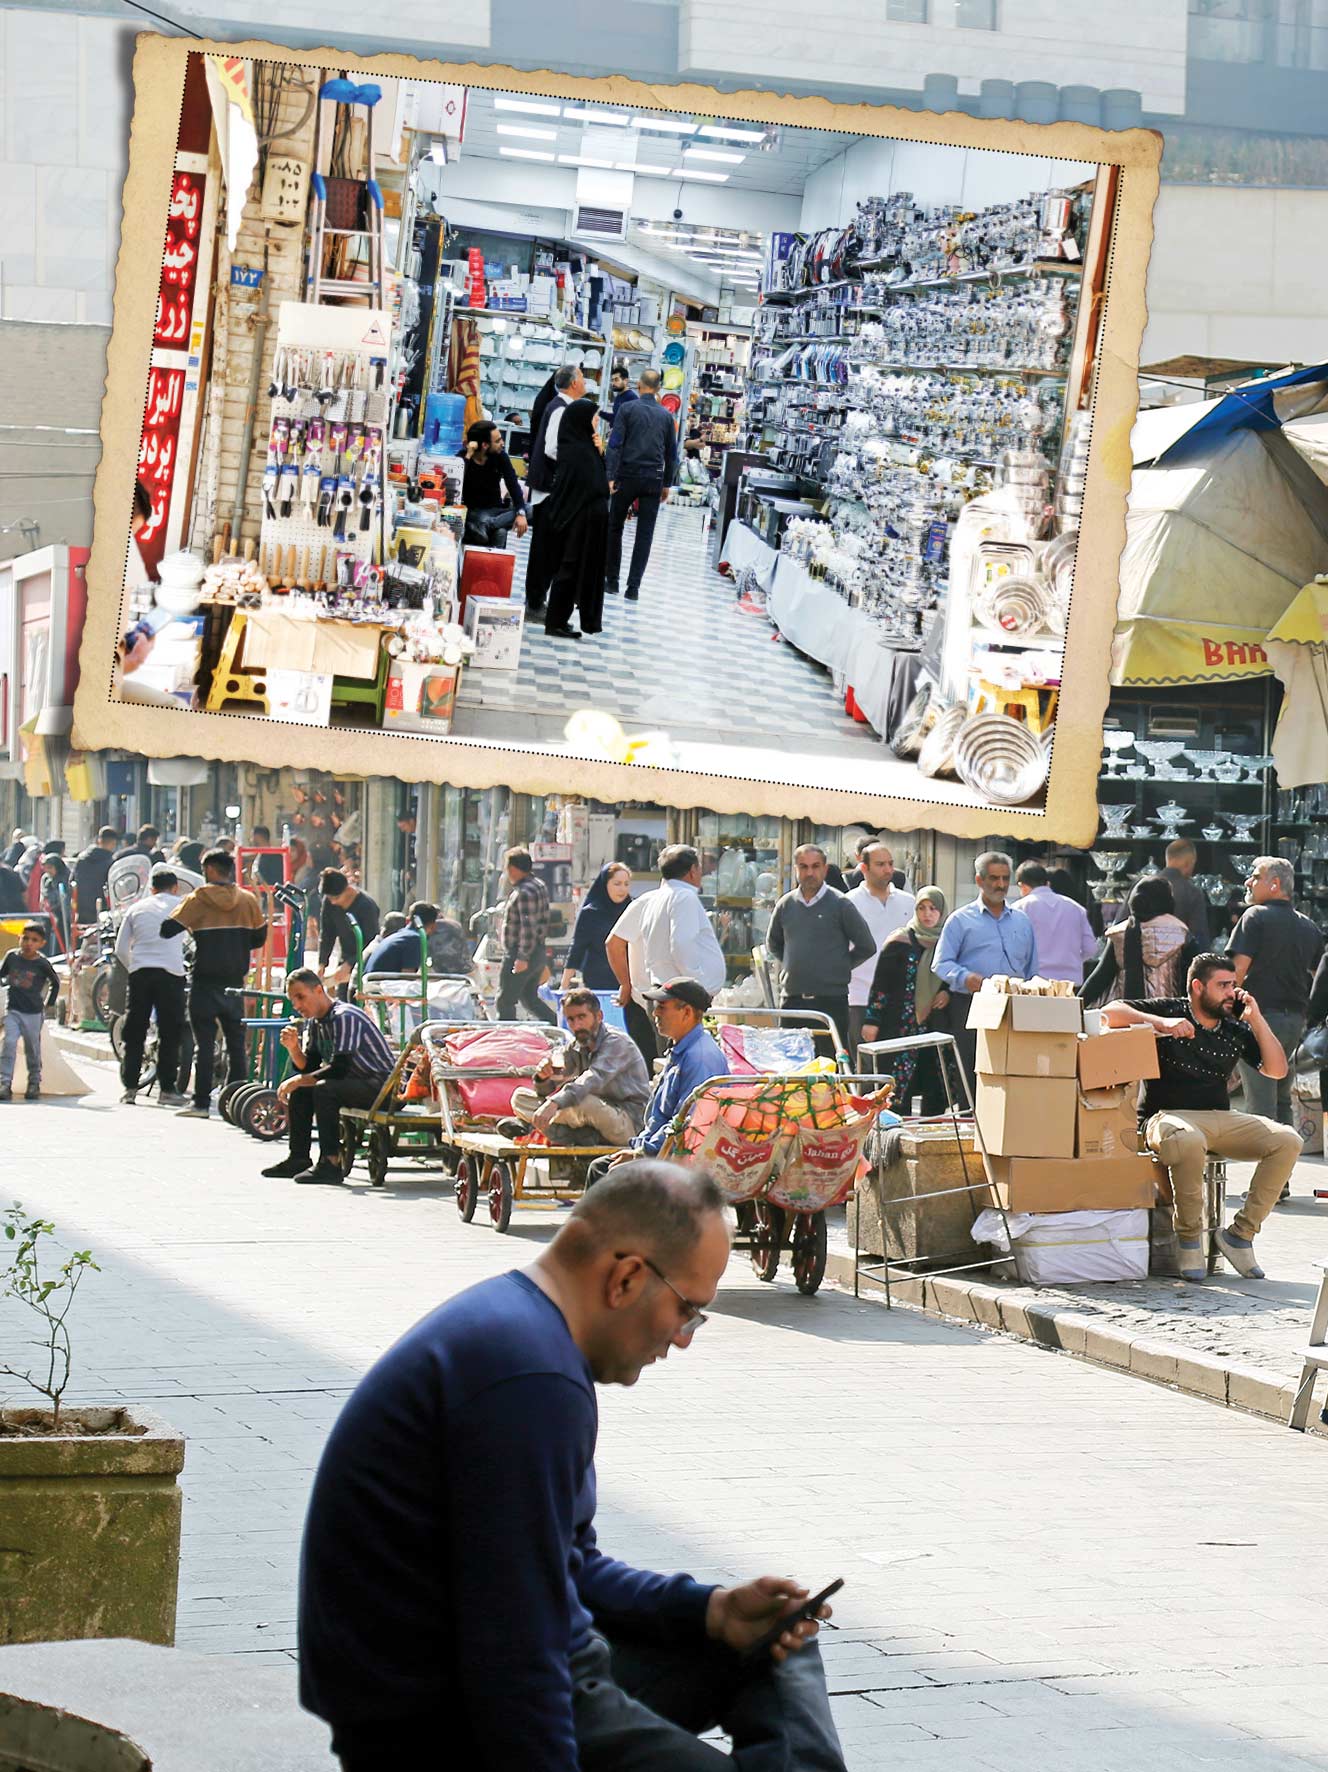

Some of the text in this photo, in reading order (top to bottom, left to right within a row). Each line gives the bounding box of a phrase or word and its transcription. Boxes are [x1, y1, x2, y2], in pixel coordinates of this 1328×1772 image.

[168, 175, 198, 235] پخ
[234, 271, 258, 285] ۱۷۲
[1201, 638, 1268, 667] BAH
[804, 1147, 839, 1159] Jahan
